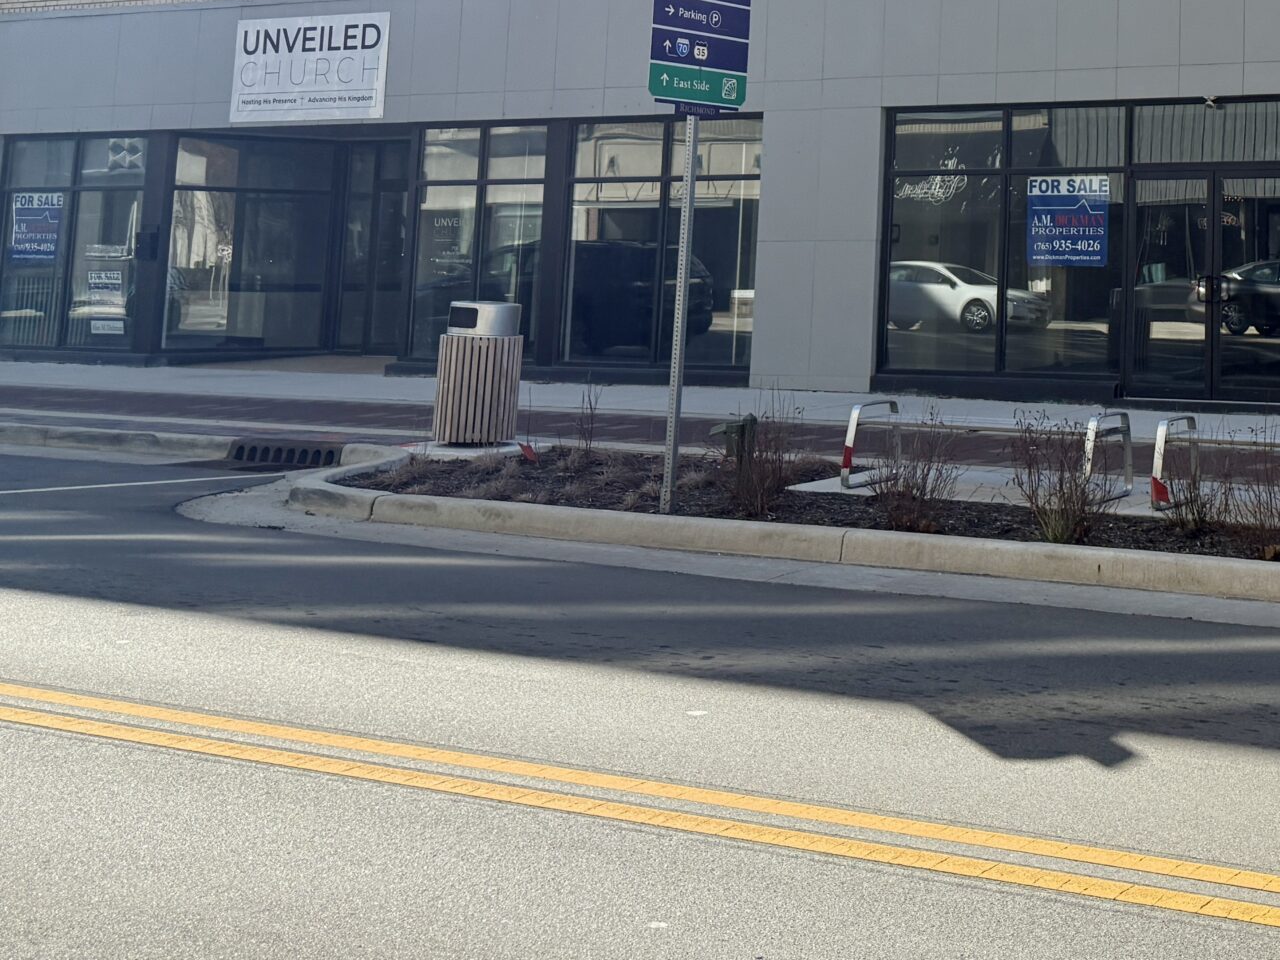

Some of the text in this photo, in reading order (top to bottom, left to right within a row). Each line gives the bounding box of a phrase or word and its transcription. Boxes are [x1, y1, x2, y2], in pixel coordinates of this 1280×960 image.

[679, 7, 707, 24] Parking
[243, 23, 382, 56] UNVEILED
[696, 47, 706, 57] 35
[240, 55, 380, 87] CHURCH
[673, 77, 710, 91] East Side
[241, 98, 262, 106] Hosting
[272, 97, 297, 105] Presence
[308, 96, 337, 104] Advancing
[348, 95, 374, 103] Kingdom
[679, 103, 716, 115] RICHMOND
[1028, 178, 1109, 194] FOR SALE
[15, 194, 63, 207] FOR SALE
[1031, 214, 1054, 227] A.M.
[1031, 227, 1105, 235] PROPERTIES
[1034, 240, 1100, 251] (765) 935-4026
